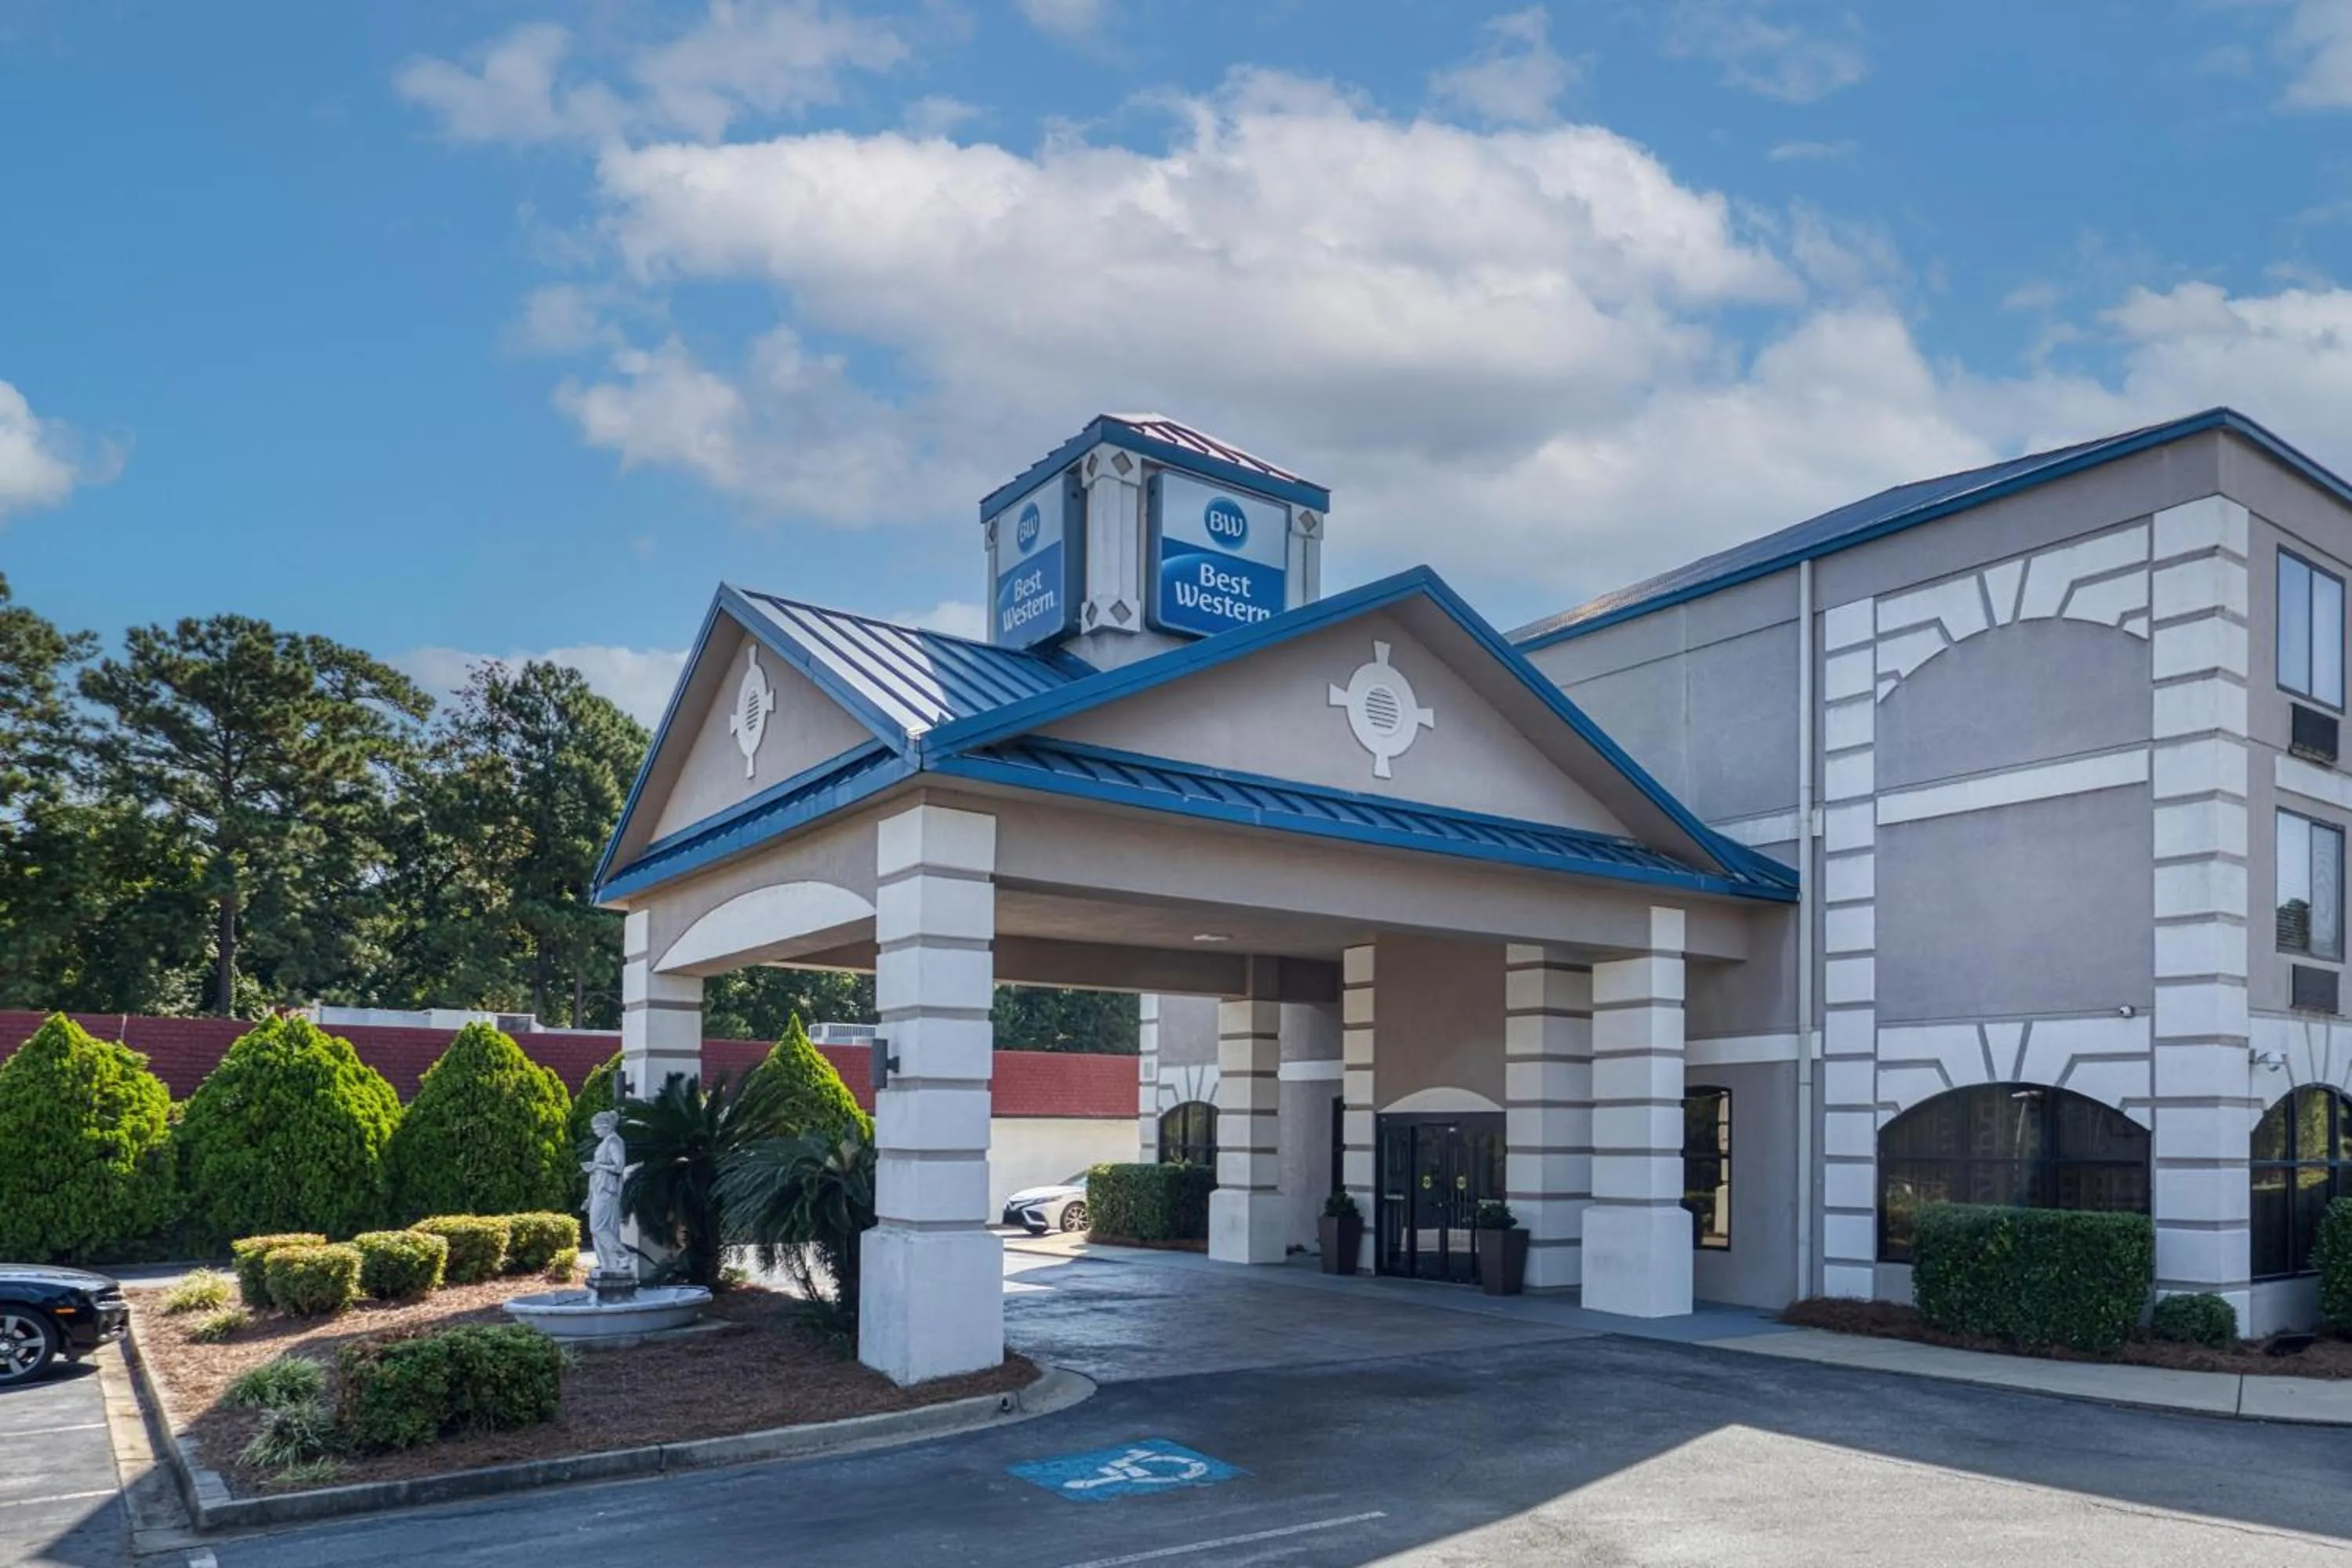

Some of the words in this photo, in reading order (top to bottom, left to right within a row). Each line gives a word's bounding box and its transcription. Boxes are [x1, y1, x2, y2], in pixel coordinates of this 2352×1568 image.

[1019, 514, 1037, 543] BW
[1210, 510, 1243, 537] BW
[1014, 569, 1042, 603] Best
[1200, 563, 1251, 597] Best
[1004, 590, 1054, 633] Western
[1175, 580, 1271, 622] Western
